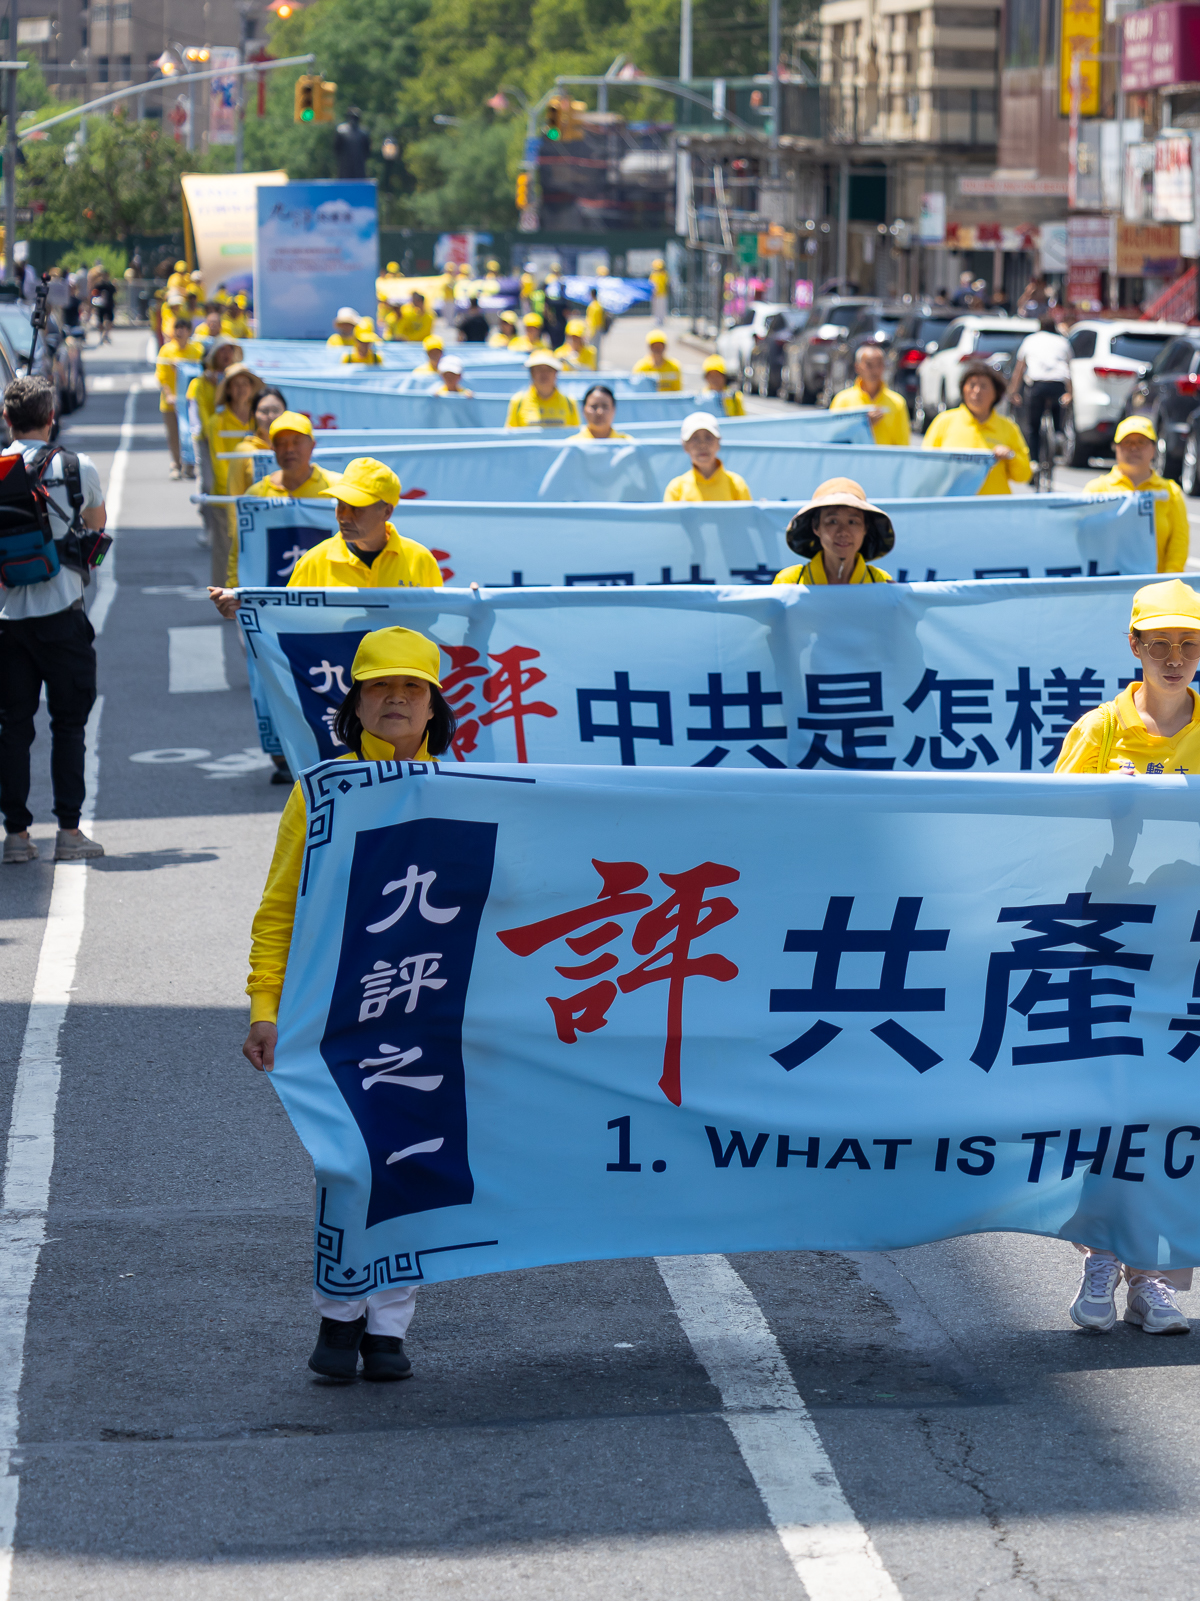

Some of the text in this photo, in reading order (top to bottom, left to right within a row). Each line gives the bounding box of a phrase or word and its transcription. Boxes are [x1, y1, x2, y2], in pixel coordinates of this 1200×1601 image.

[357, 864, 461, 1165] 九評之一
[605, 1115, 668, 1173] 1.
[703, 1124, 912, 1169] WHAT
[935, 1135, 996, 1177] IS
[1020, 1122, 1147, 1184] THE
